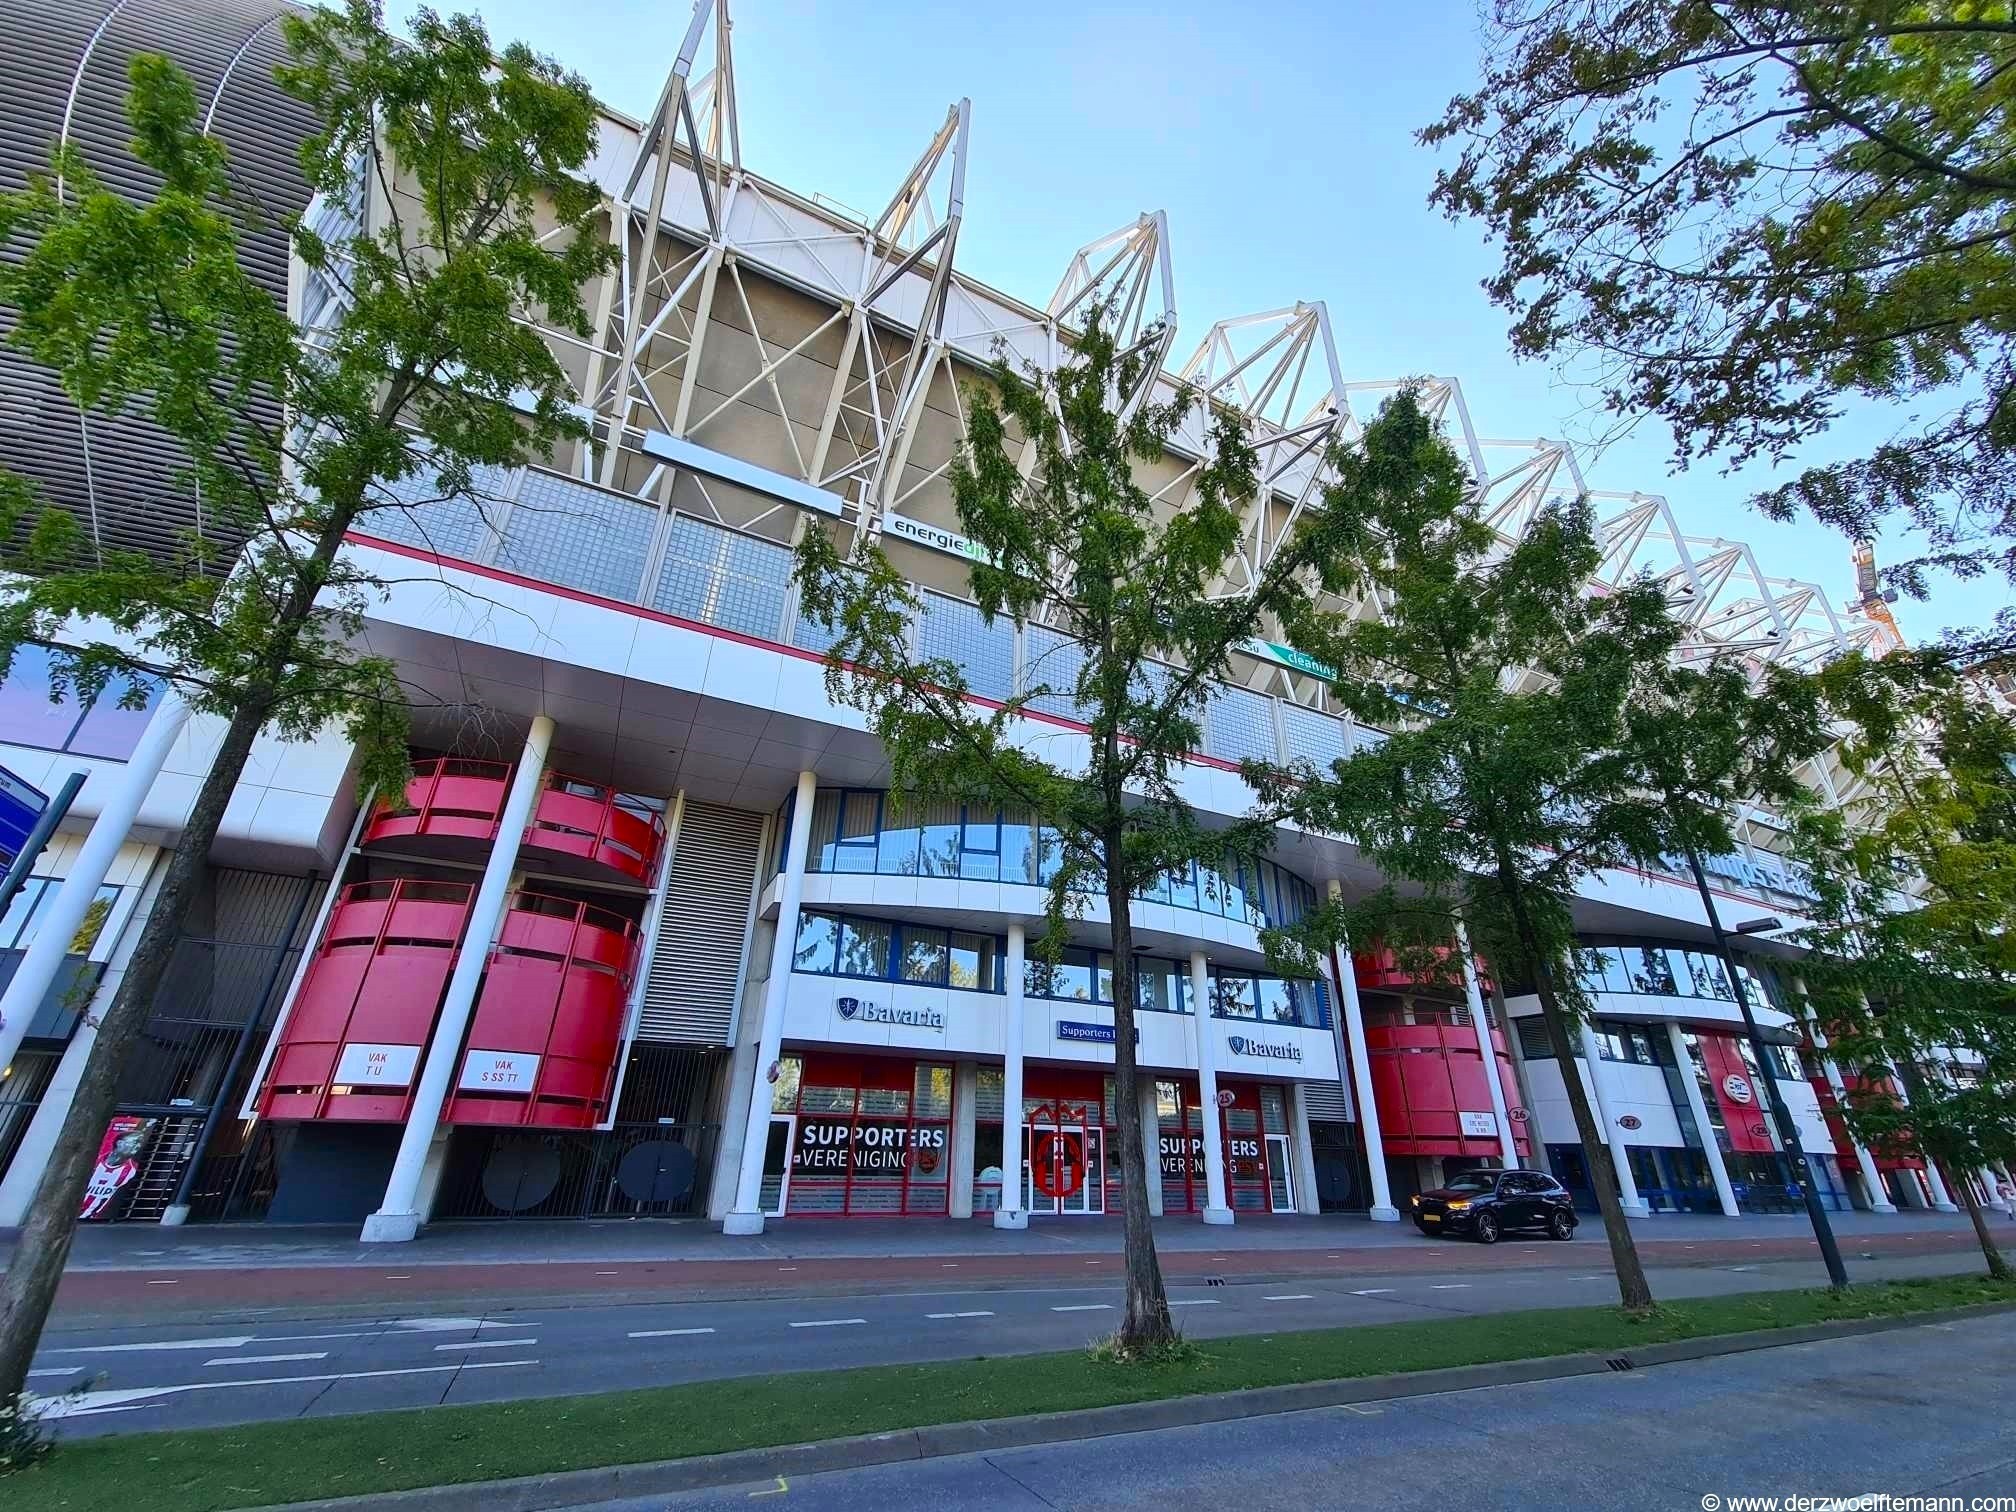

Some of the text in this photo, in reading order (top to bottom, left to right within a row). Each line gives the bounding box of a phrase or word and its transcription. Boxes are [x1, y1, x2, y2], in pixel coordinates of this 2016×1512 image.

[862, 1000, 945, 1028] Bavaria
[1062, 1025, 1111, 1039] Supporters
[1246, 1039, 1304, 1060] Bavaria
[368, 1052, 388, 1063] VAK
[495, 1060, 513, 1070] VAK
[374, 1066, 382, 1076] U
[481, 1072, 489, 1082] S
[491, 1072, 504, 1083] SS
[1220, 1094, 1231, 1104] 25
[1513, 1110, 1526, 1120] 26
[1624, 1118, 1636, 1128] 27
[803, 1124, 944, 1148] SUPPORTERS
